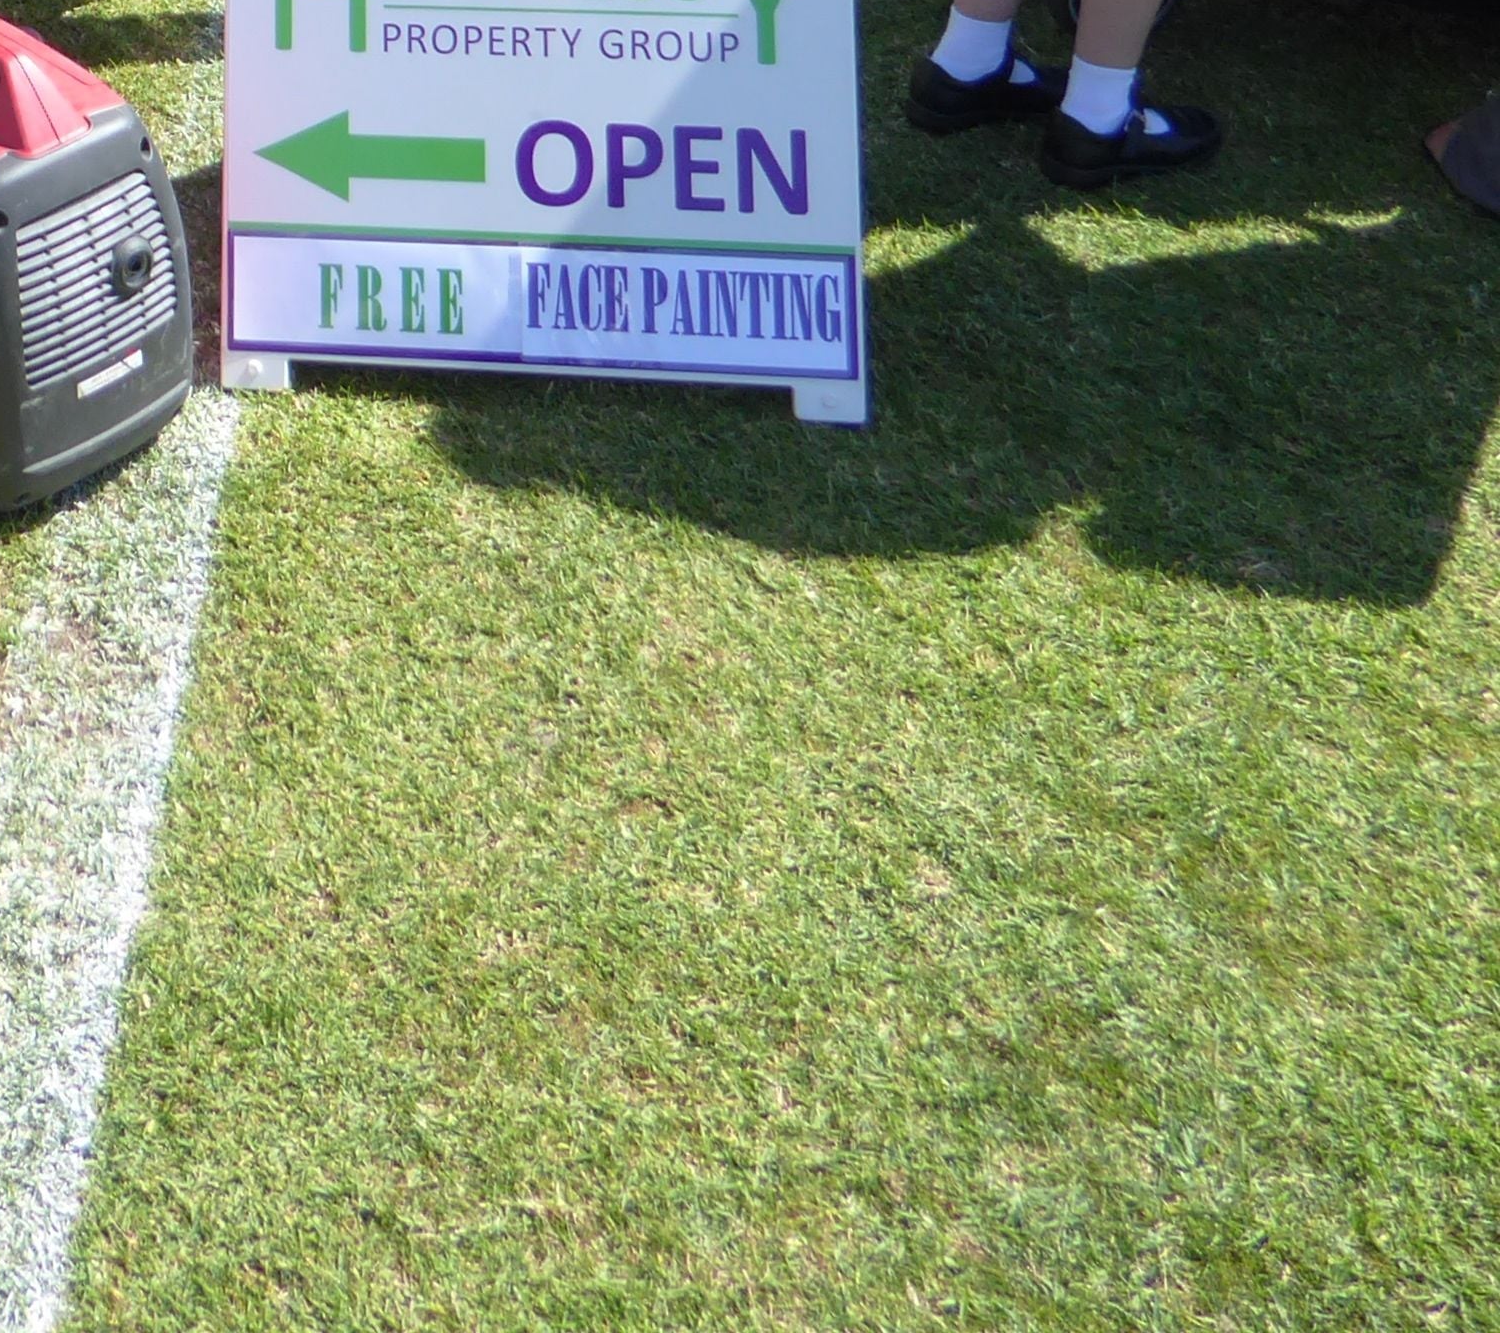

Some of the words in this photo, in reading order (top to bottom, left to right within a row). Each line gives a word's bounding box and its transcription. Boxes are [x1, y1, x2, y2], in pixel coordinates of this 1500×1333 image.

[382, 23, 582, 60] PROPERTY
[599, 29, 741, 63] GROUP
[515, 119, 809, 215] OPEN
[318, 263, 464, 335] FREE
[526, 262, 629, 333] FACE
[640, 267, 843, 342] PAINTING
